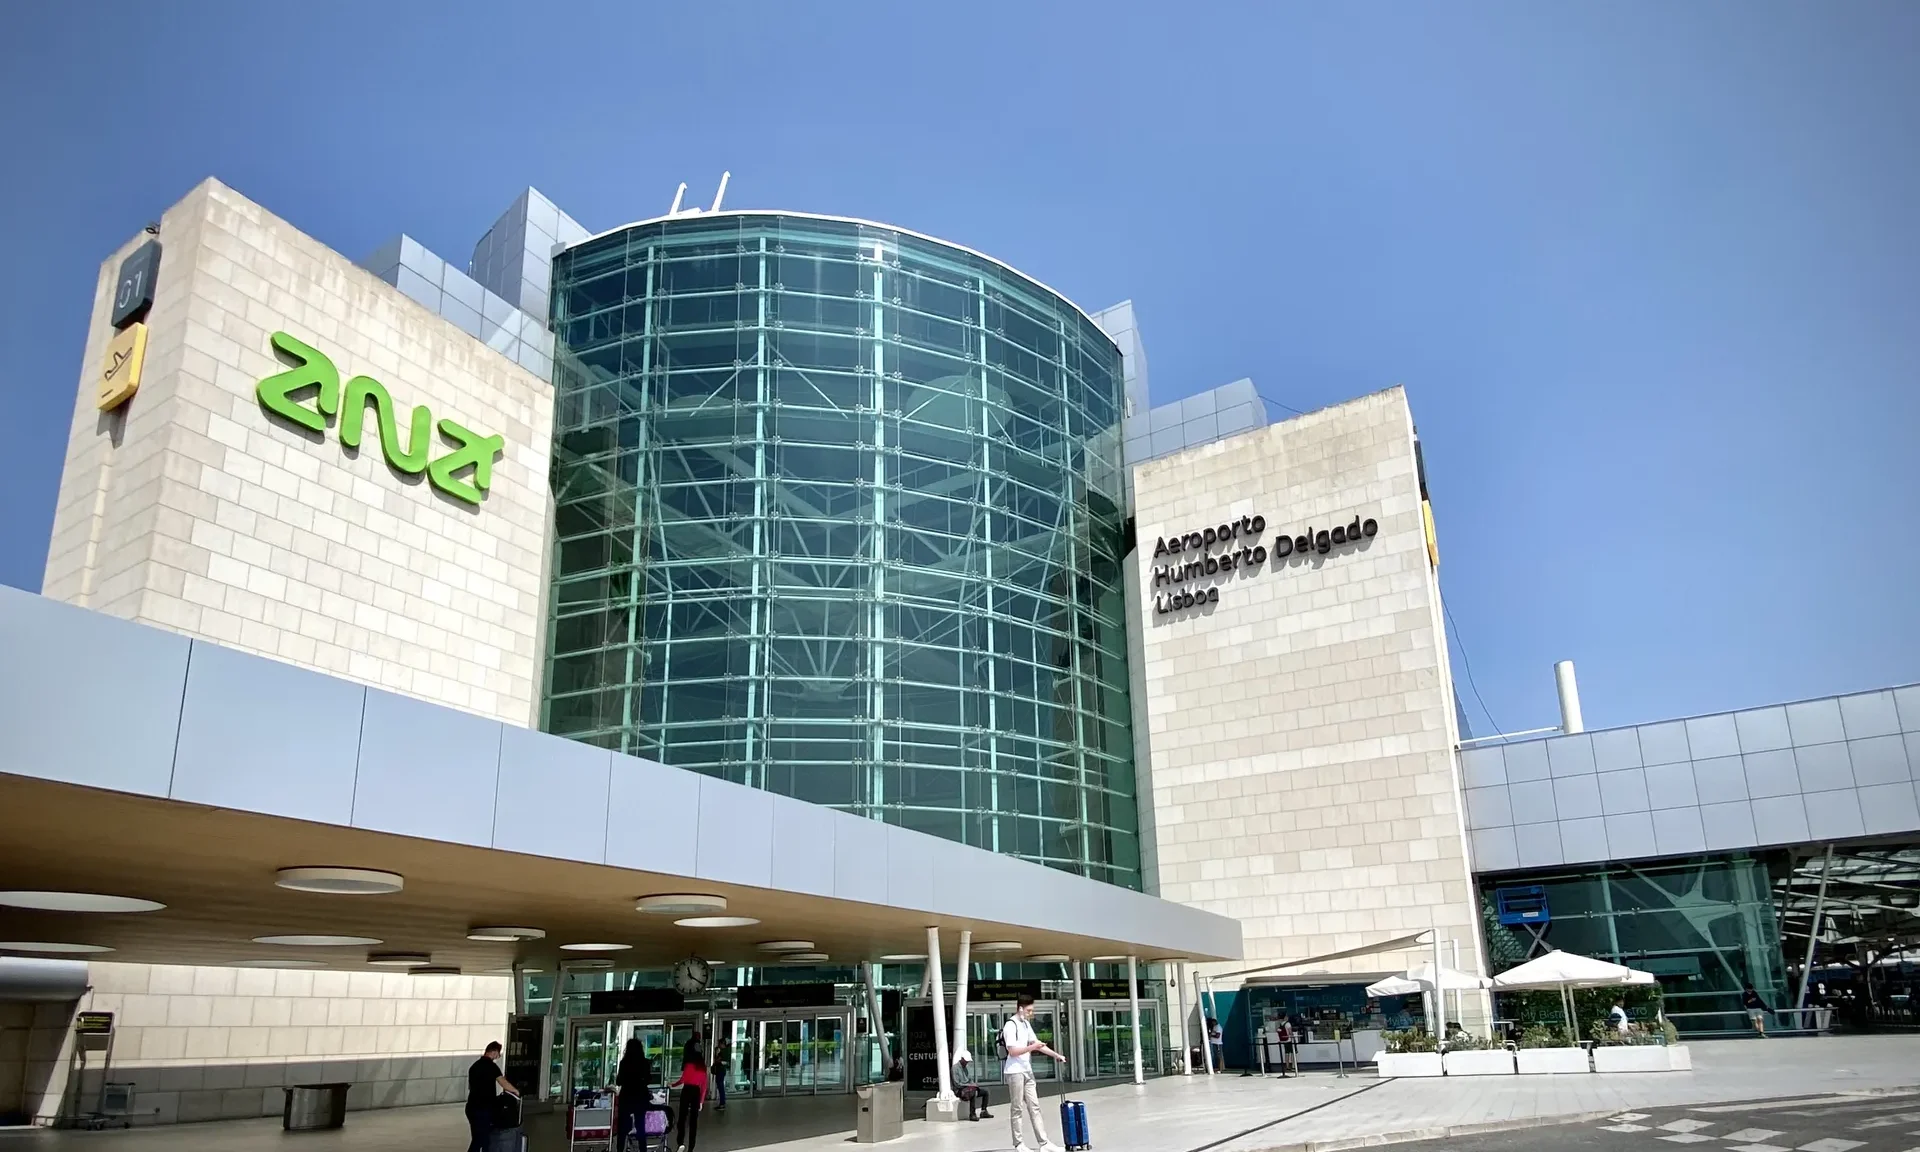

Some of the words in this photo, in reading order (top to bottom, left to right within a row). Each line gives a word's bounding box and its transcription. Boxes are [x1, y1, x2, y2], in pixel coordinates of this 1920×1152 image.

[1153, 515, 1266, 558] Aeroporto
[1154, 545, 1267, 587] Humberto
[1275, 515, 1379, 558] Delgado
[1156, 585, 1219, 614] Lisboa
[1520, 1011, 1536, 1021] My
[908, 1052, 937, 1061] CENTUR
